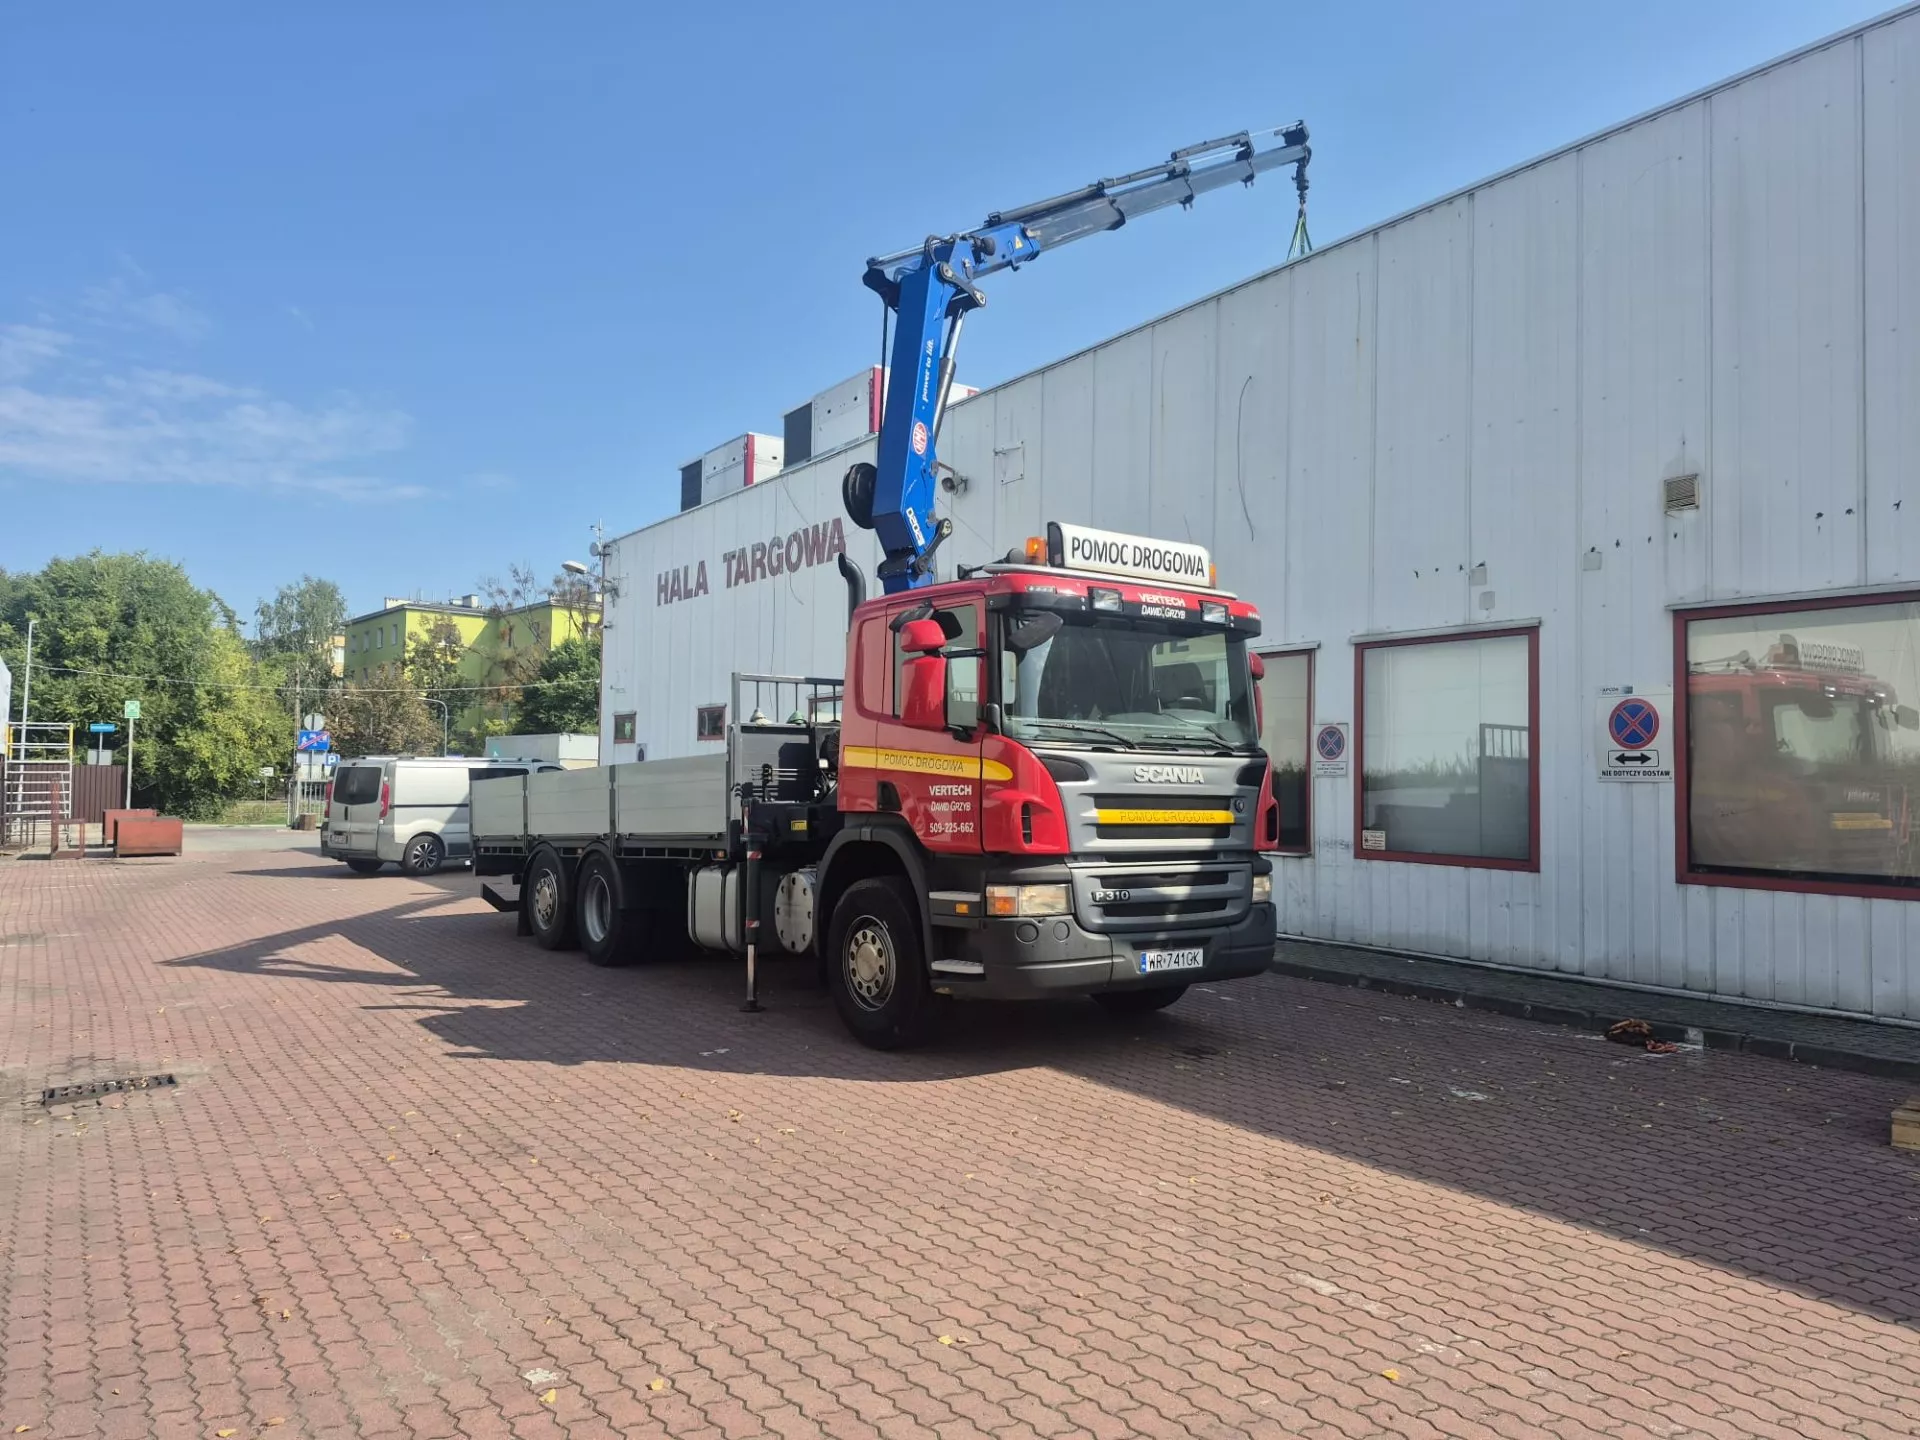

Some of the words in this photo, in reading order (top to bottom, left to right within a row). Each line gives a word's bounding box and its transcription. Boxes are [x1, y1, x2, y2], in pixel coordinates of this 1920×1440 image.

[922, 369, 930, 403] power
[926, 357, 932, 368] to
[657, 560, 709, 607] HALA
[723, 516, 847, 589] TARGOWA
[1071, 536, 1128, 566] POMOC
[1133, 545, 1205, 577] DROGOWA
[1138, 592, 1186, 607] VERTECH
[1165, 607, 1186, 619] GRZYB
[884, 753, 914, 766] POMOC
[916, 757, 964, 773] DROGOWA
[1134, 767, 1205, 784] SCANIA
[929, 785, 972, 796] VERTECH
[950, 801, 971, 811] GRZYB
[1120, 811, 1160, 822] POMOC
[930, 822, 974, 833] 509-225-662
[1095, 891, 1104, 900] P
[1107, 890, 1129, 900] 310
[1148, 953, 1163, 968] WR
[1167, 951, 1200, 967] 741GK
